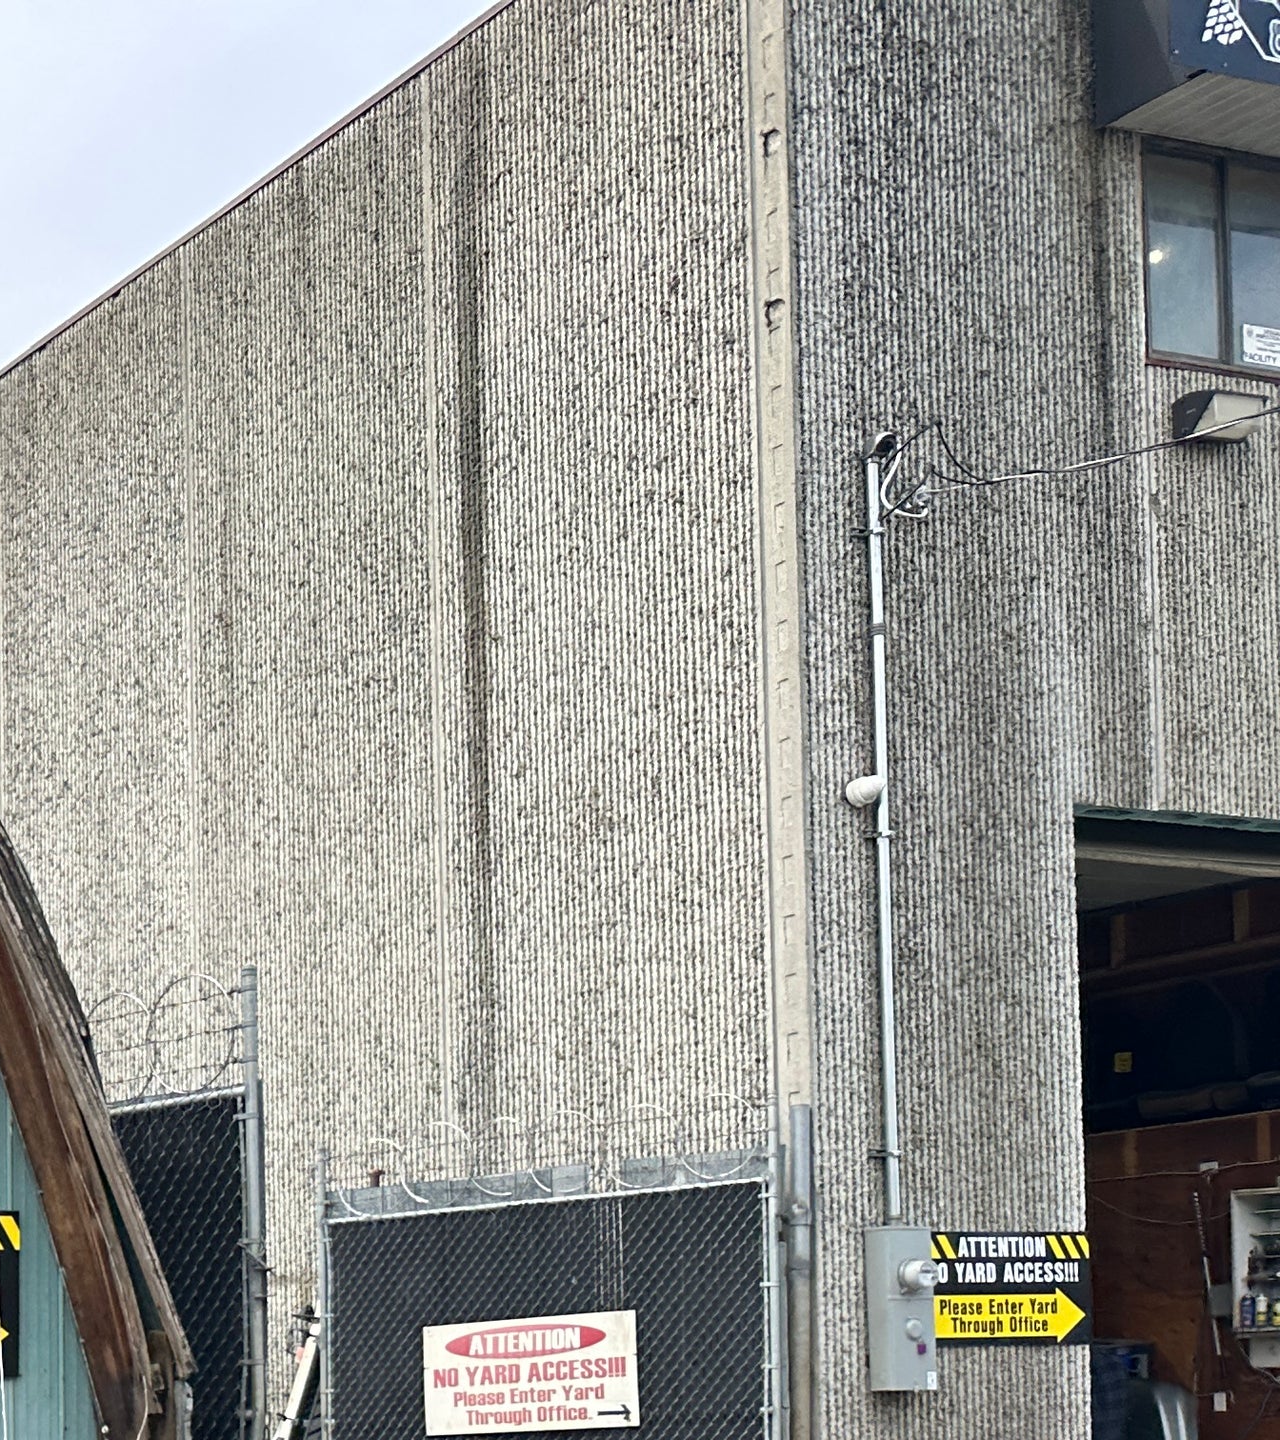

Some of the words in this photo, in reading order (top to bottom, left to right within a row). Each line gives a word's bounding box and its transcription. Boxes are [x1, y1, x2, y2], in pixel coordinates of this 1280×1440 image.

[957, 1236, 1046, 1258] ATTENTION
[954, 1262, 997, 1283] YARD
[1003, 1262, 1080, 1283] ACCESS!!!
[940, 1299, 983, 1315] Please
[989, 1299, 1024, 1315] Enter
[1029, 1298, 1058, 1314] Yard
[950, 1316, 1004, 1335] Through
[1010, 1317, 1049, 1332] Office
[468, 1327, 582, 1356] ATTENTION
[433, 1368, 459, 1388] NO
[465, 1363, 521, 1387] YARD
[527, 1356, 627, 1384] ACCESS!!!
[453, 1391, 506, 1408] Please
[510, 1388, 557, 1405] Enter
[561, 1384, 605, 1401] Yard
[466, 1409, 533, 1426] Through
